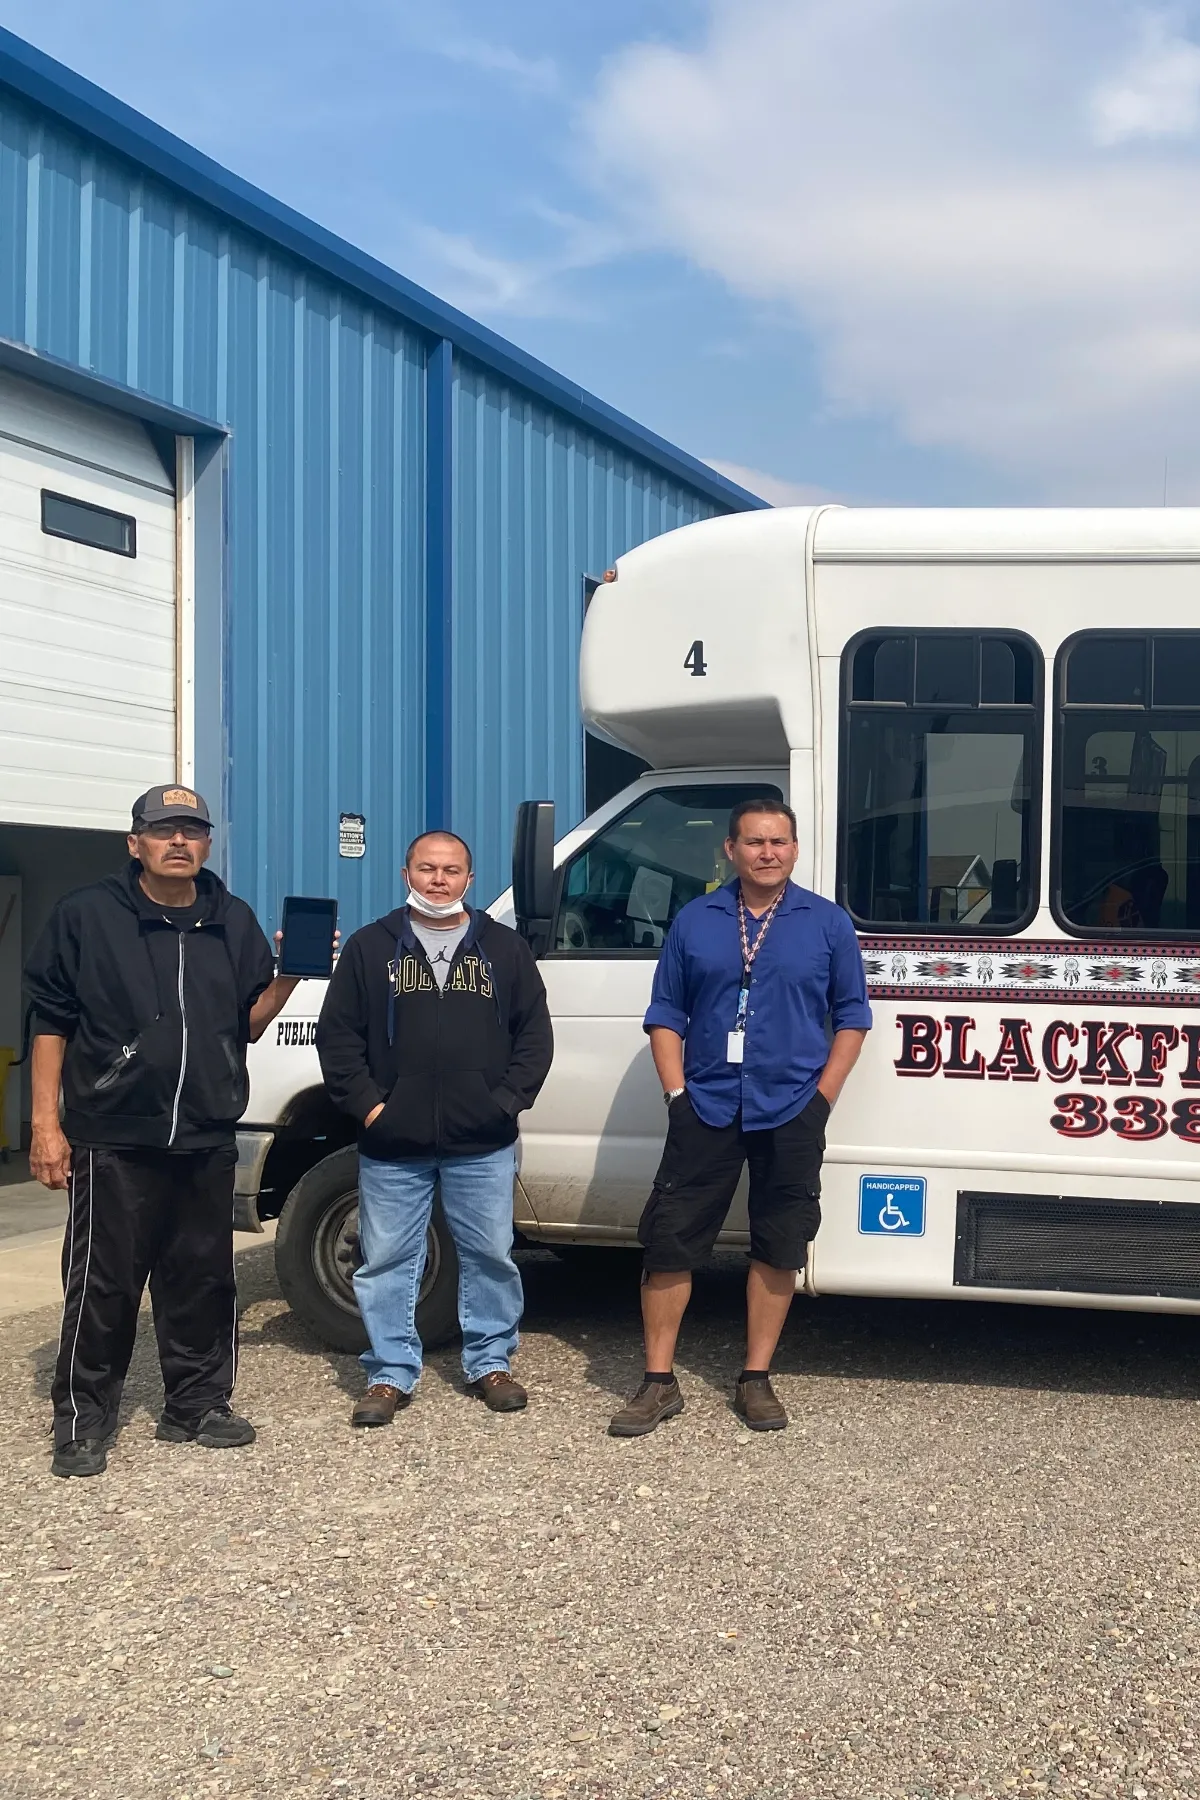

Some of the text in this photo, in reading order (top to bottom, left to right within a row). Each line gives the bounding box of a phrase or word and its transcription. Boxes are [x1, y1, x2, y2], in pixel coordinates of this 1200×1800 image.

[683, 640, 708, 677] 4
[387, 955, 493, 998] BOBATS
[276, 1021, 318, 1046] PUBLIC
[866, 1182, 920, 1191] HANDICAPPED
